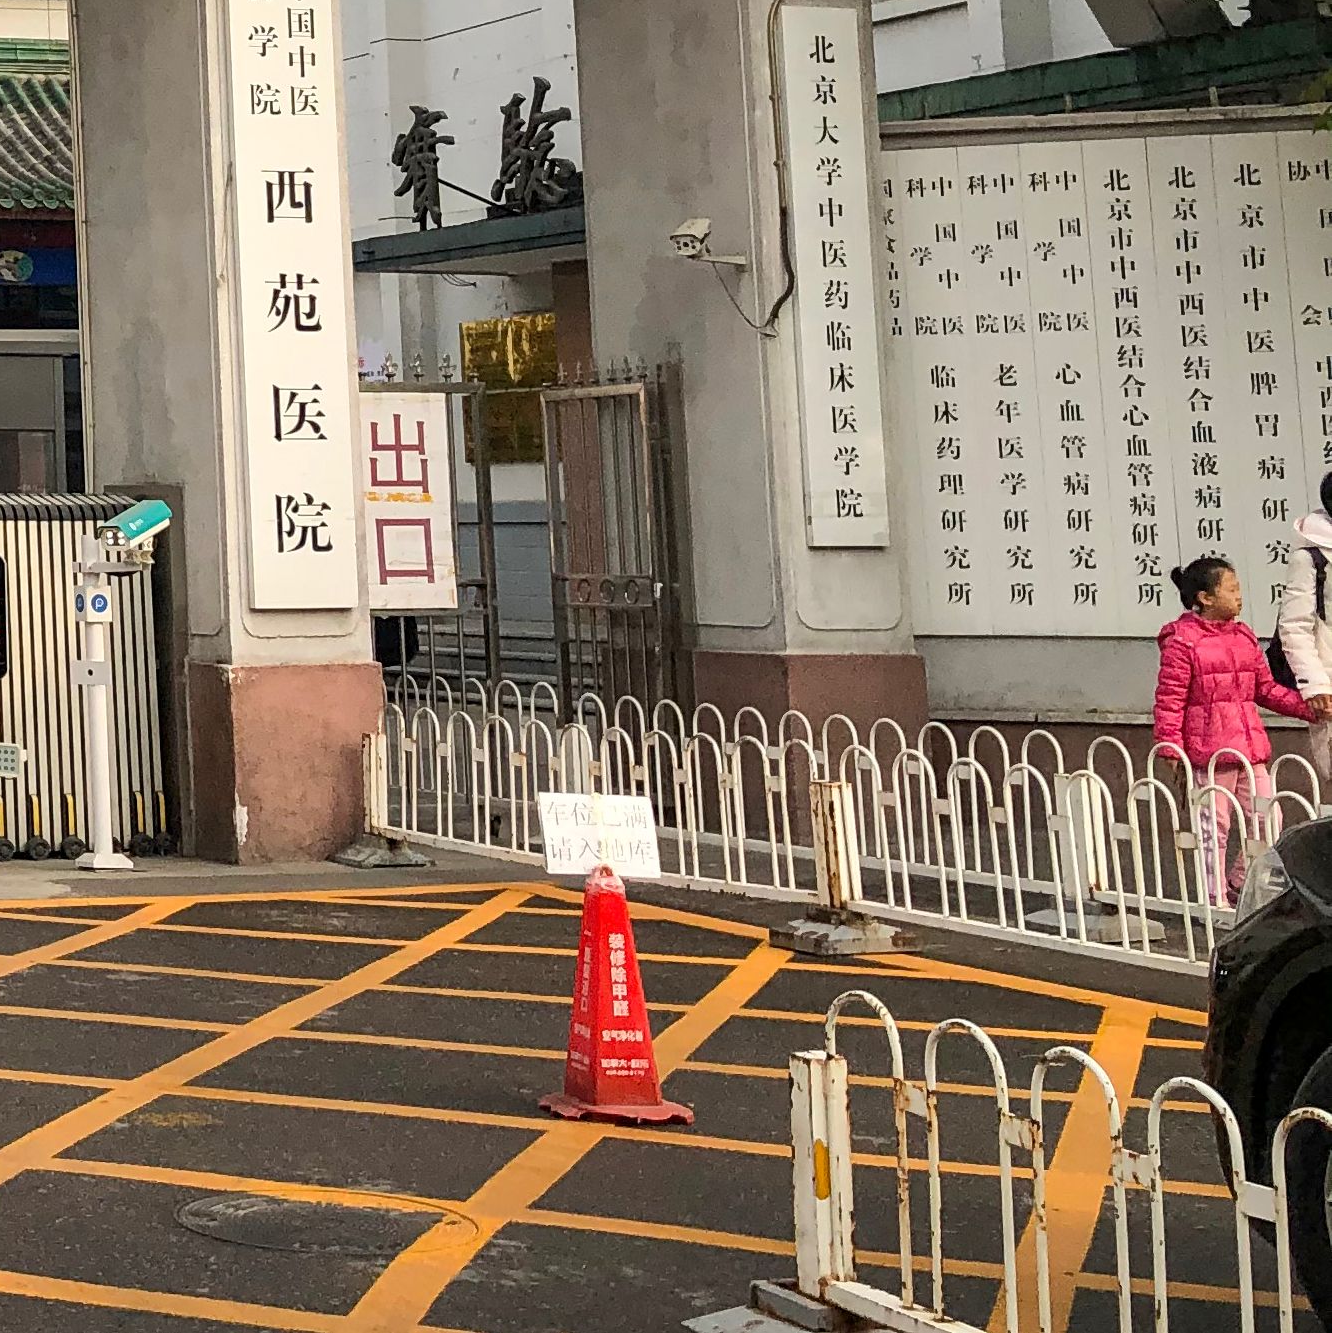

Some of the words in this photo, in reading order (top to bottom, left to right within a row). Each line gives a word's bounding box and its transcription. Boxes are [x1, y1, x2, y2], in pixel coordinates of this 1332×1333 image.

[808, 34, 864, 519] 北京大学中医药临床医学院
[905, 178, 939, 336] 科学院
[931, 176, 965, 336] 中国中医
[966, 174, 999, 334] 科学院
[993, 173, 1027, 335] 中国中医
[1028, 171, 1063, 333] 科学院
[1055, 170, 1090, 332] 中国中医
[261, 167, 334, 555] 西苑医院
[1103, 168, 1163, 606] 北京市中西医结合心血管病研究所
[369, 412, 435, 585] 出口
[930, 365, 972, 606] 临床药理研究所
[993, 363, 1035, 606] 老年医学研究所
[1055, 363, 1098, 606] 心血管病研究所
[608, 932, 630, 1017] 装修除甲醛
